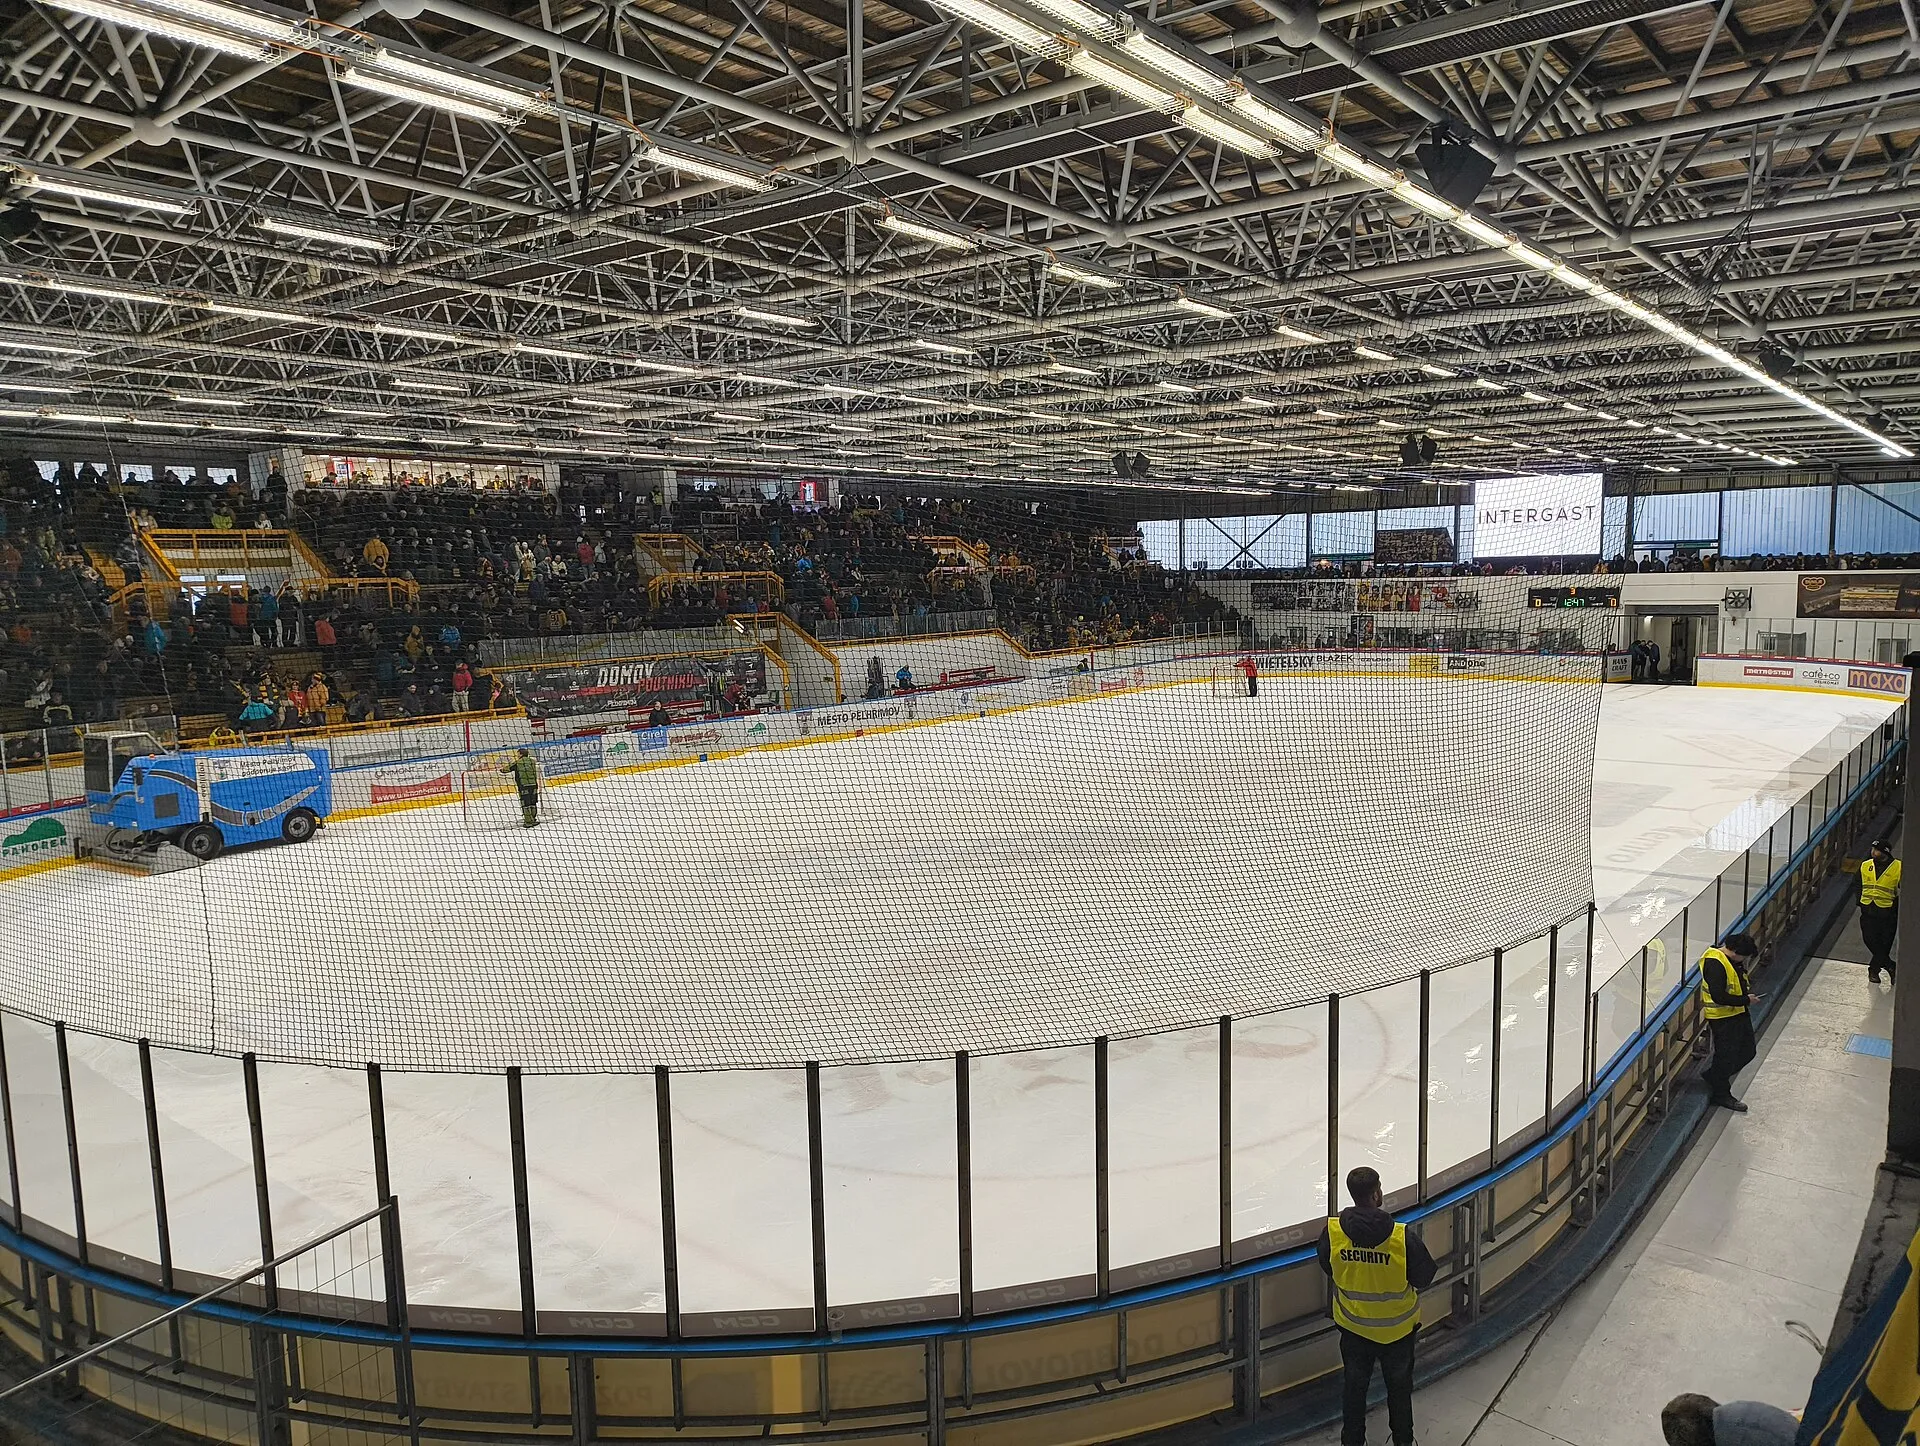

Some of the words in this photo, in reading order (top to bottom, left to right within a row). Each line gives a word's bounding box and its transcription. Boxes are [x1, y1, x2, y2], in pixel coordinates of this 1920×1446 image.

[1478, 505, 1597, 524] INTERGAST
[1570, 587, 1576, 595] 3
[1535, 598, 1542, 607] 0
[1563, 598, 1585, 607] 12:47
[1610, 598, 1617, 607] 0
[1252, 655, 1314, 669] WIETELSKY
[597, 662, 655, 688] DOMOV
[1849, 669, 1906, 693] maxa
[1339, 1248, 1391, 1266] SECURITY
